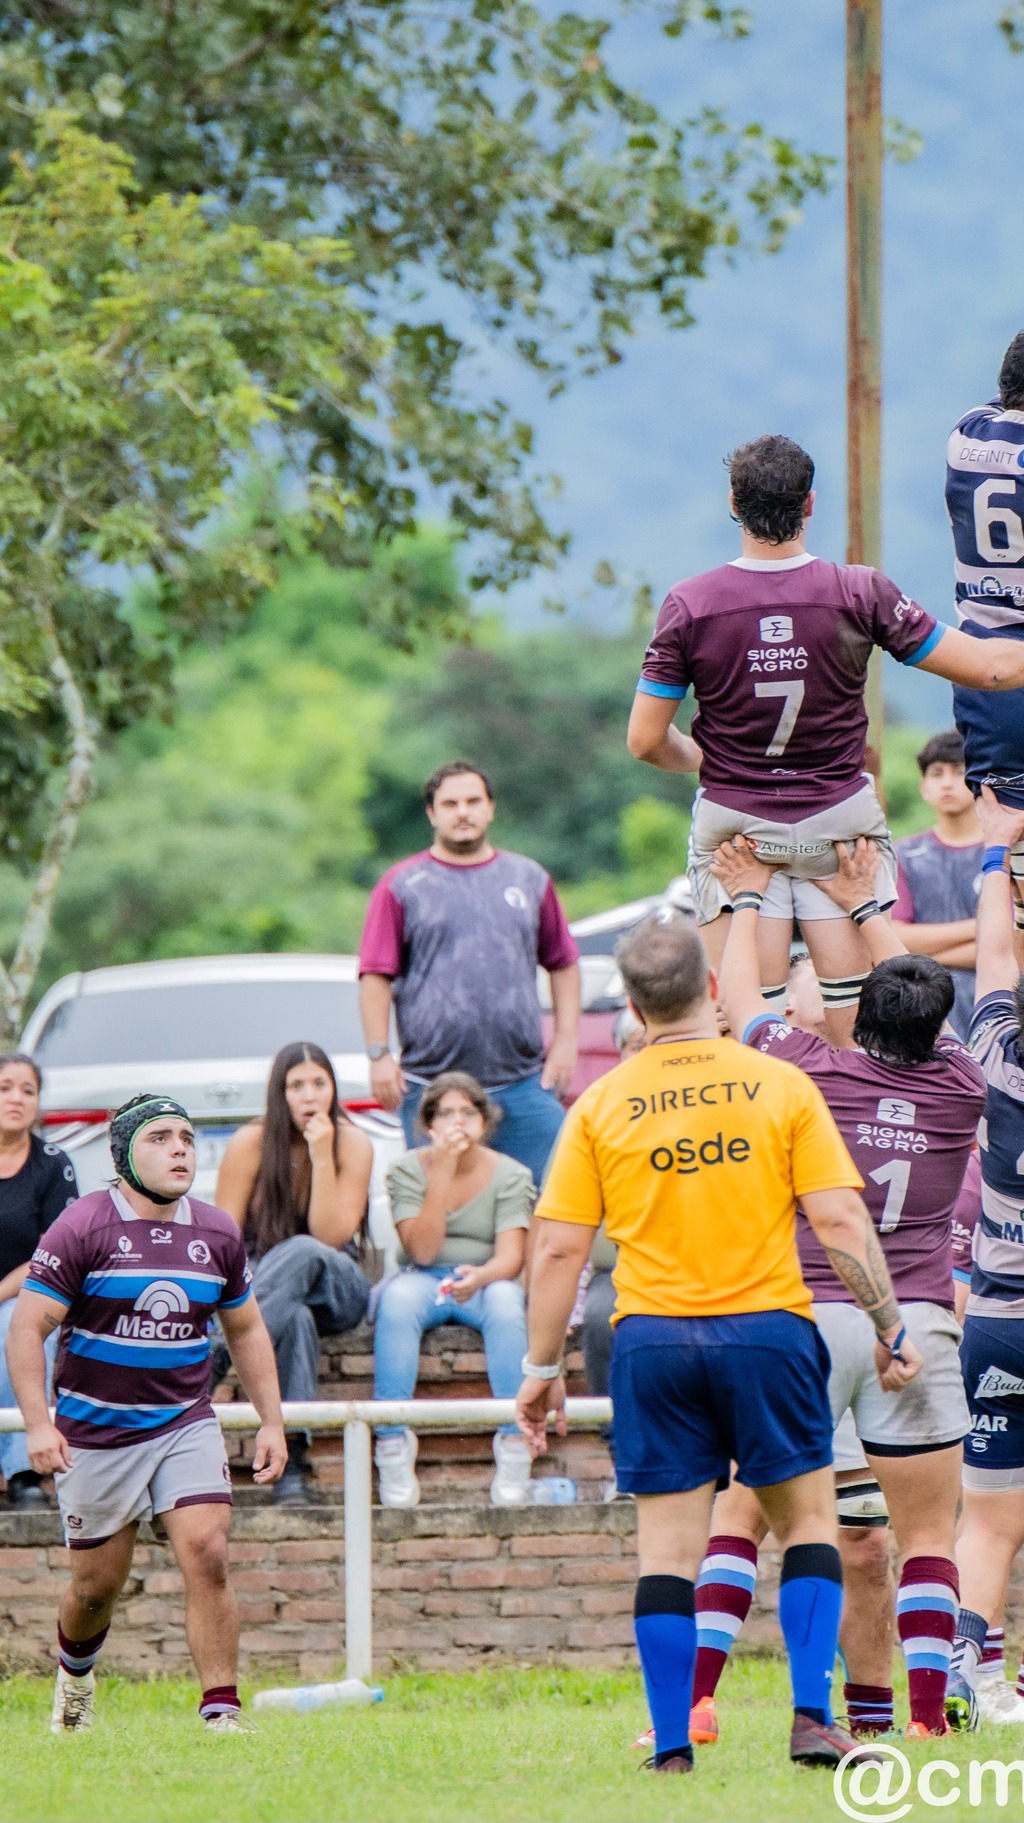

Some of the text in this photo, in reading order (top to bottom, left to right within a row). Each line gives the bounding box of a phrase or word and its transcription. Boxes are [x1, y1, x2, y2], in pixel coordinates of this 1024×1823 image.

[747, 647, 808, 661] SIGMA
[749, 659, 808, 672] AGRO
[754, 680, 805, 757] 7
[627, 1081, 761, 1122] DIRECTV
[856, 1123, 928, 1144] SIGMA
[856, 1135, 928, 1154] AGRO
[650, 1132, 751, 1174] osde
[868, 1159, 912, 1233] 1
[114, 1314, 193, 1340] Macro
